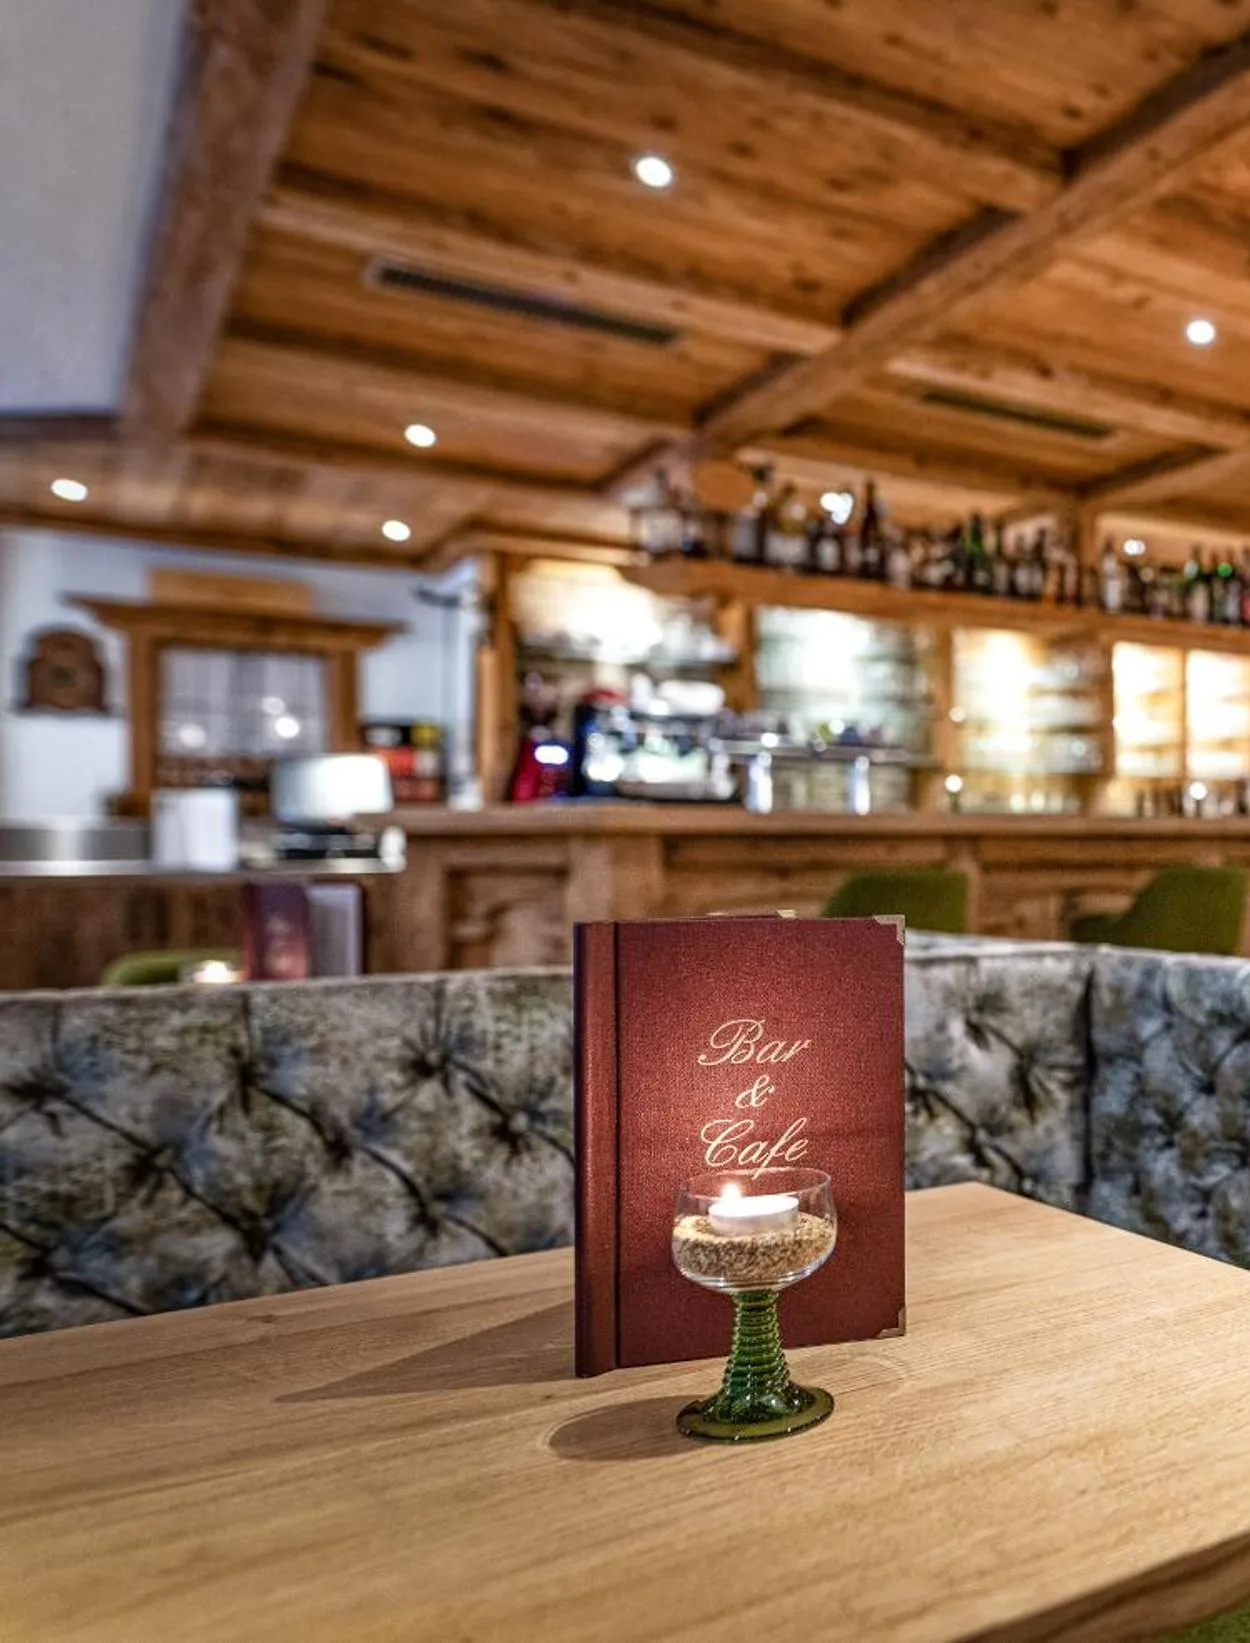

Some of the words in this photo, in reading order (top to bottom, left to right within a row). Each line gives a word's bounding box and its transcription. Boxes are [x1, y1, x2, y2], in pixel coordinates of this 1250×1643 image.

[698, 1018, 811, 1066] Bar
[735, 1074, 775, 1109] &
[700, 1117, 809, 1180] Cafe
